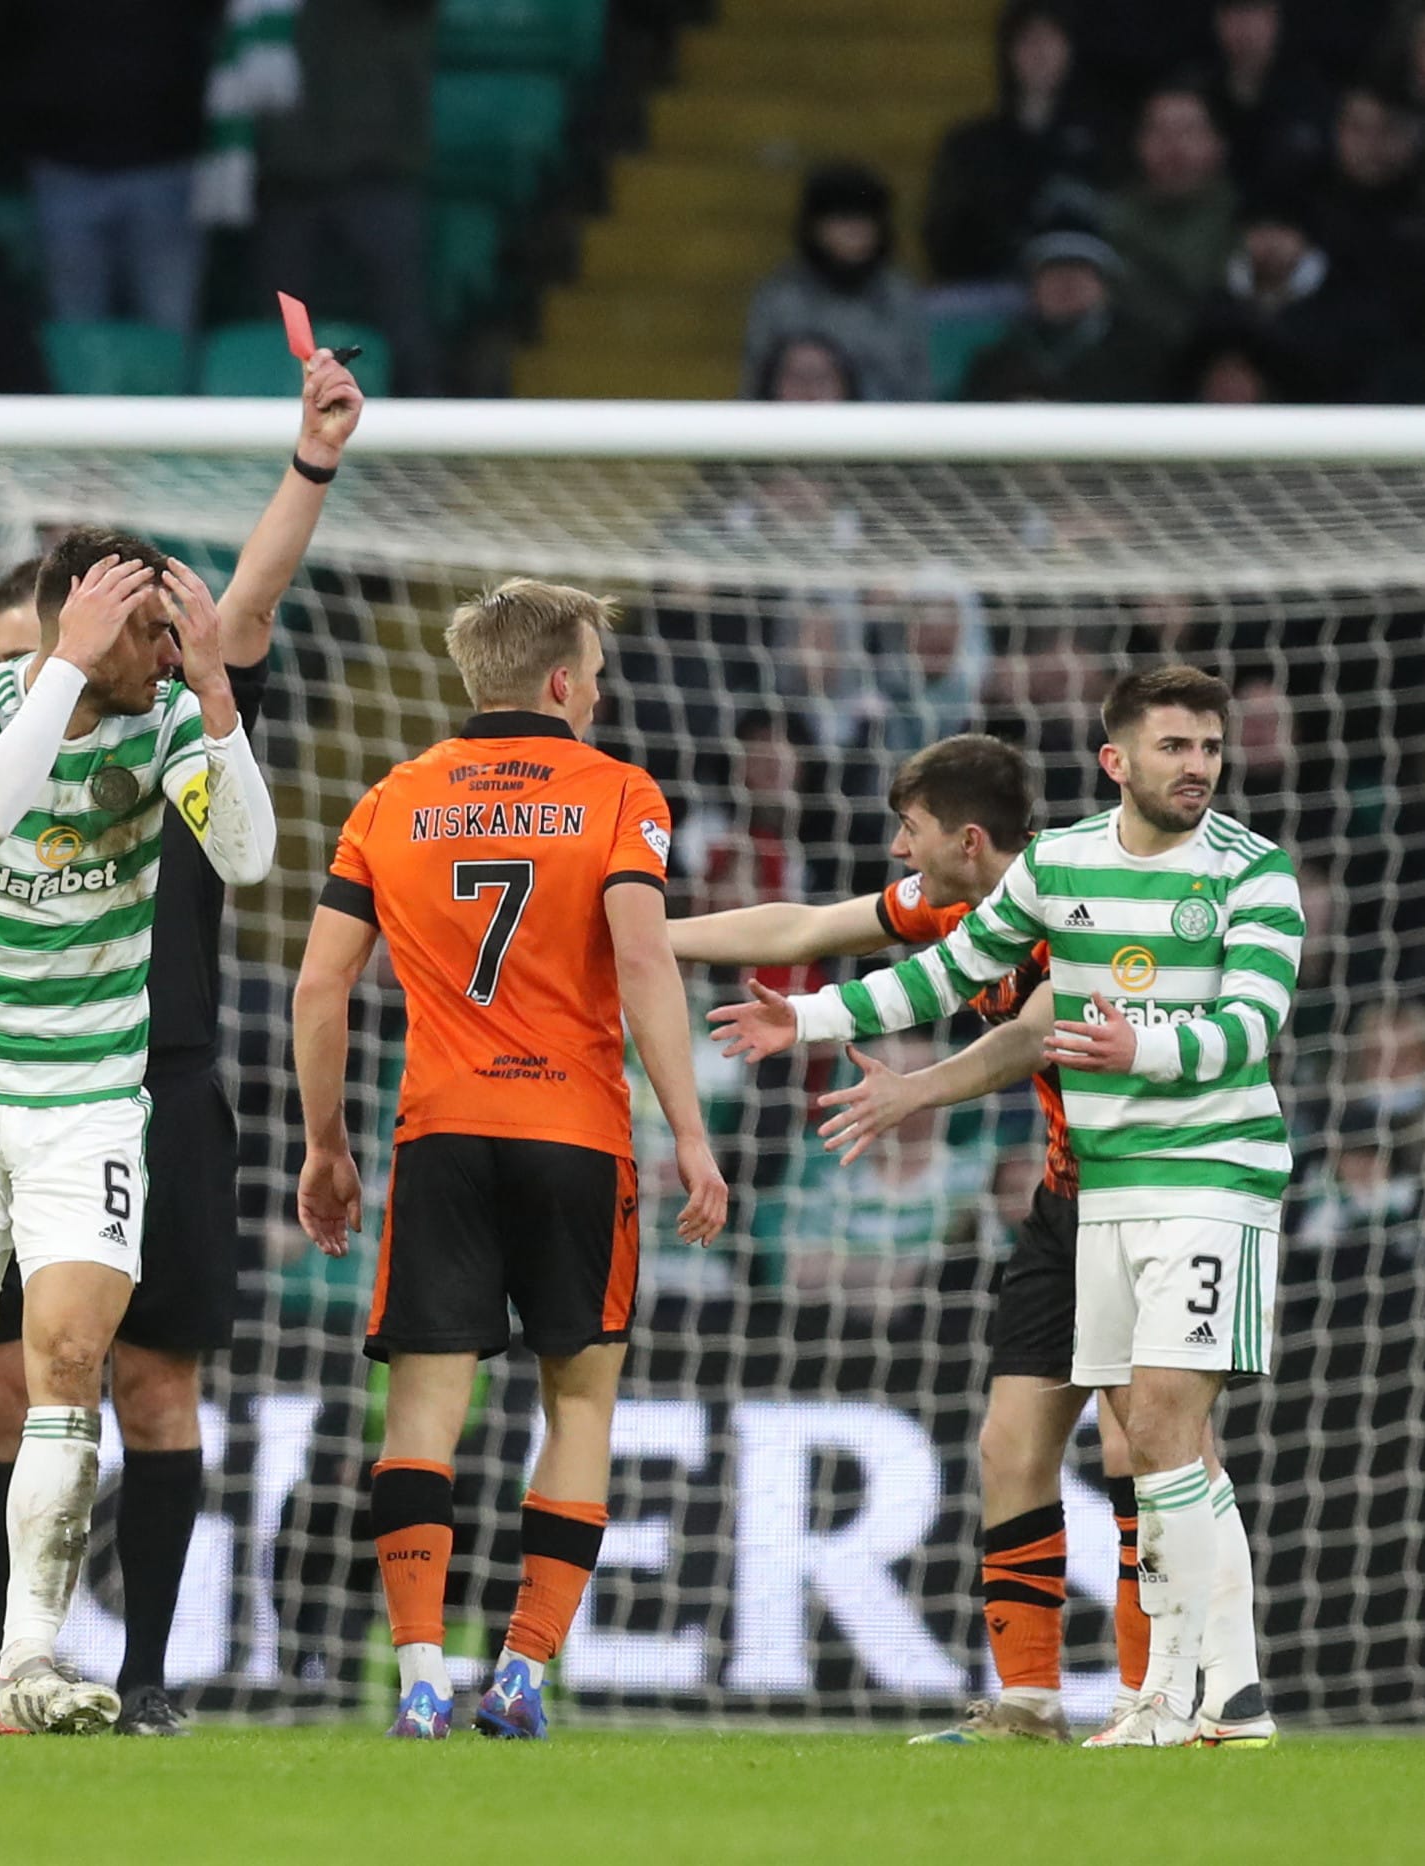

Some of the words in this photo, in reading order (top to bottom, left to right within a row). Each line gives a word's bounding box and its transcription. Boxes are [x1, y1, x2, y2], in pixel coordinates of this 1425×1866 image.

[468, 780, 525, 792] SCOTLAND
[411, 804, 586, 842] NISKANEN
[452, 860, 534, 1006] 7
[1065, 919, 1095, 928] adidas
[1083, 997, 1206, 1027] dfabet
[104, 1161, 130, 1220] 6
[98, 1231, 128, 1247] adidas
[1187, 1255, 1221, 1315] 3
[1185, 1336, 1217, 1345] adidas
